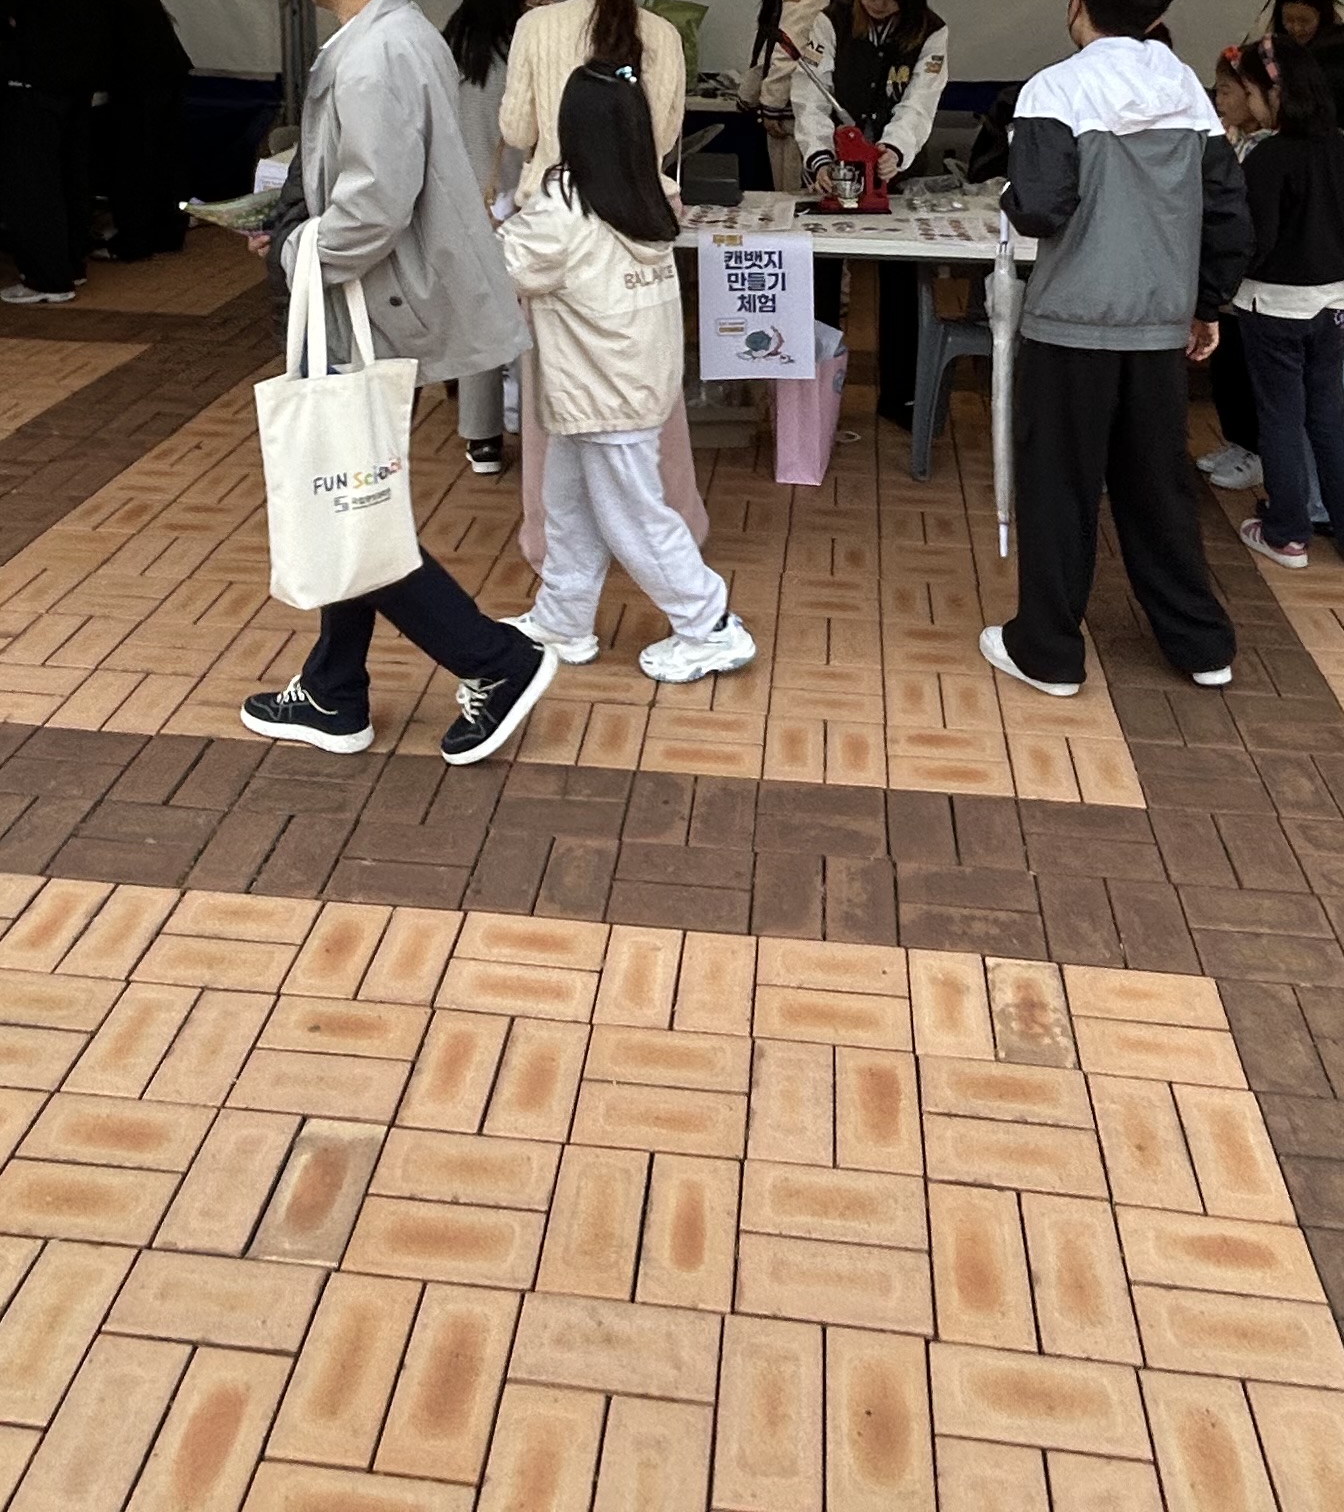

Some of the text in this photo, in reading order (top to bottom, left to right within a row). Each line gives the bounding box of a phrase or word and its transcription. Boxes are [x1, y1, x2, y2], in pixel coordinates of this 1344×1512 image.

[723, 250, 783, 270] 캔뱃지
[727, 272, 787, 292] 만들기
[736, 294, 777, 313] 체험
[312, 472, 348, 496] FUN
